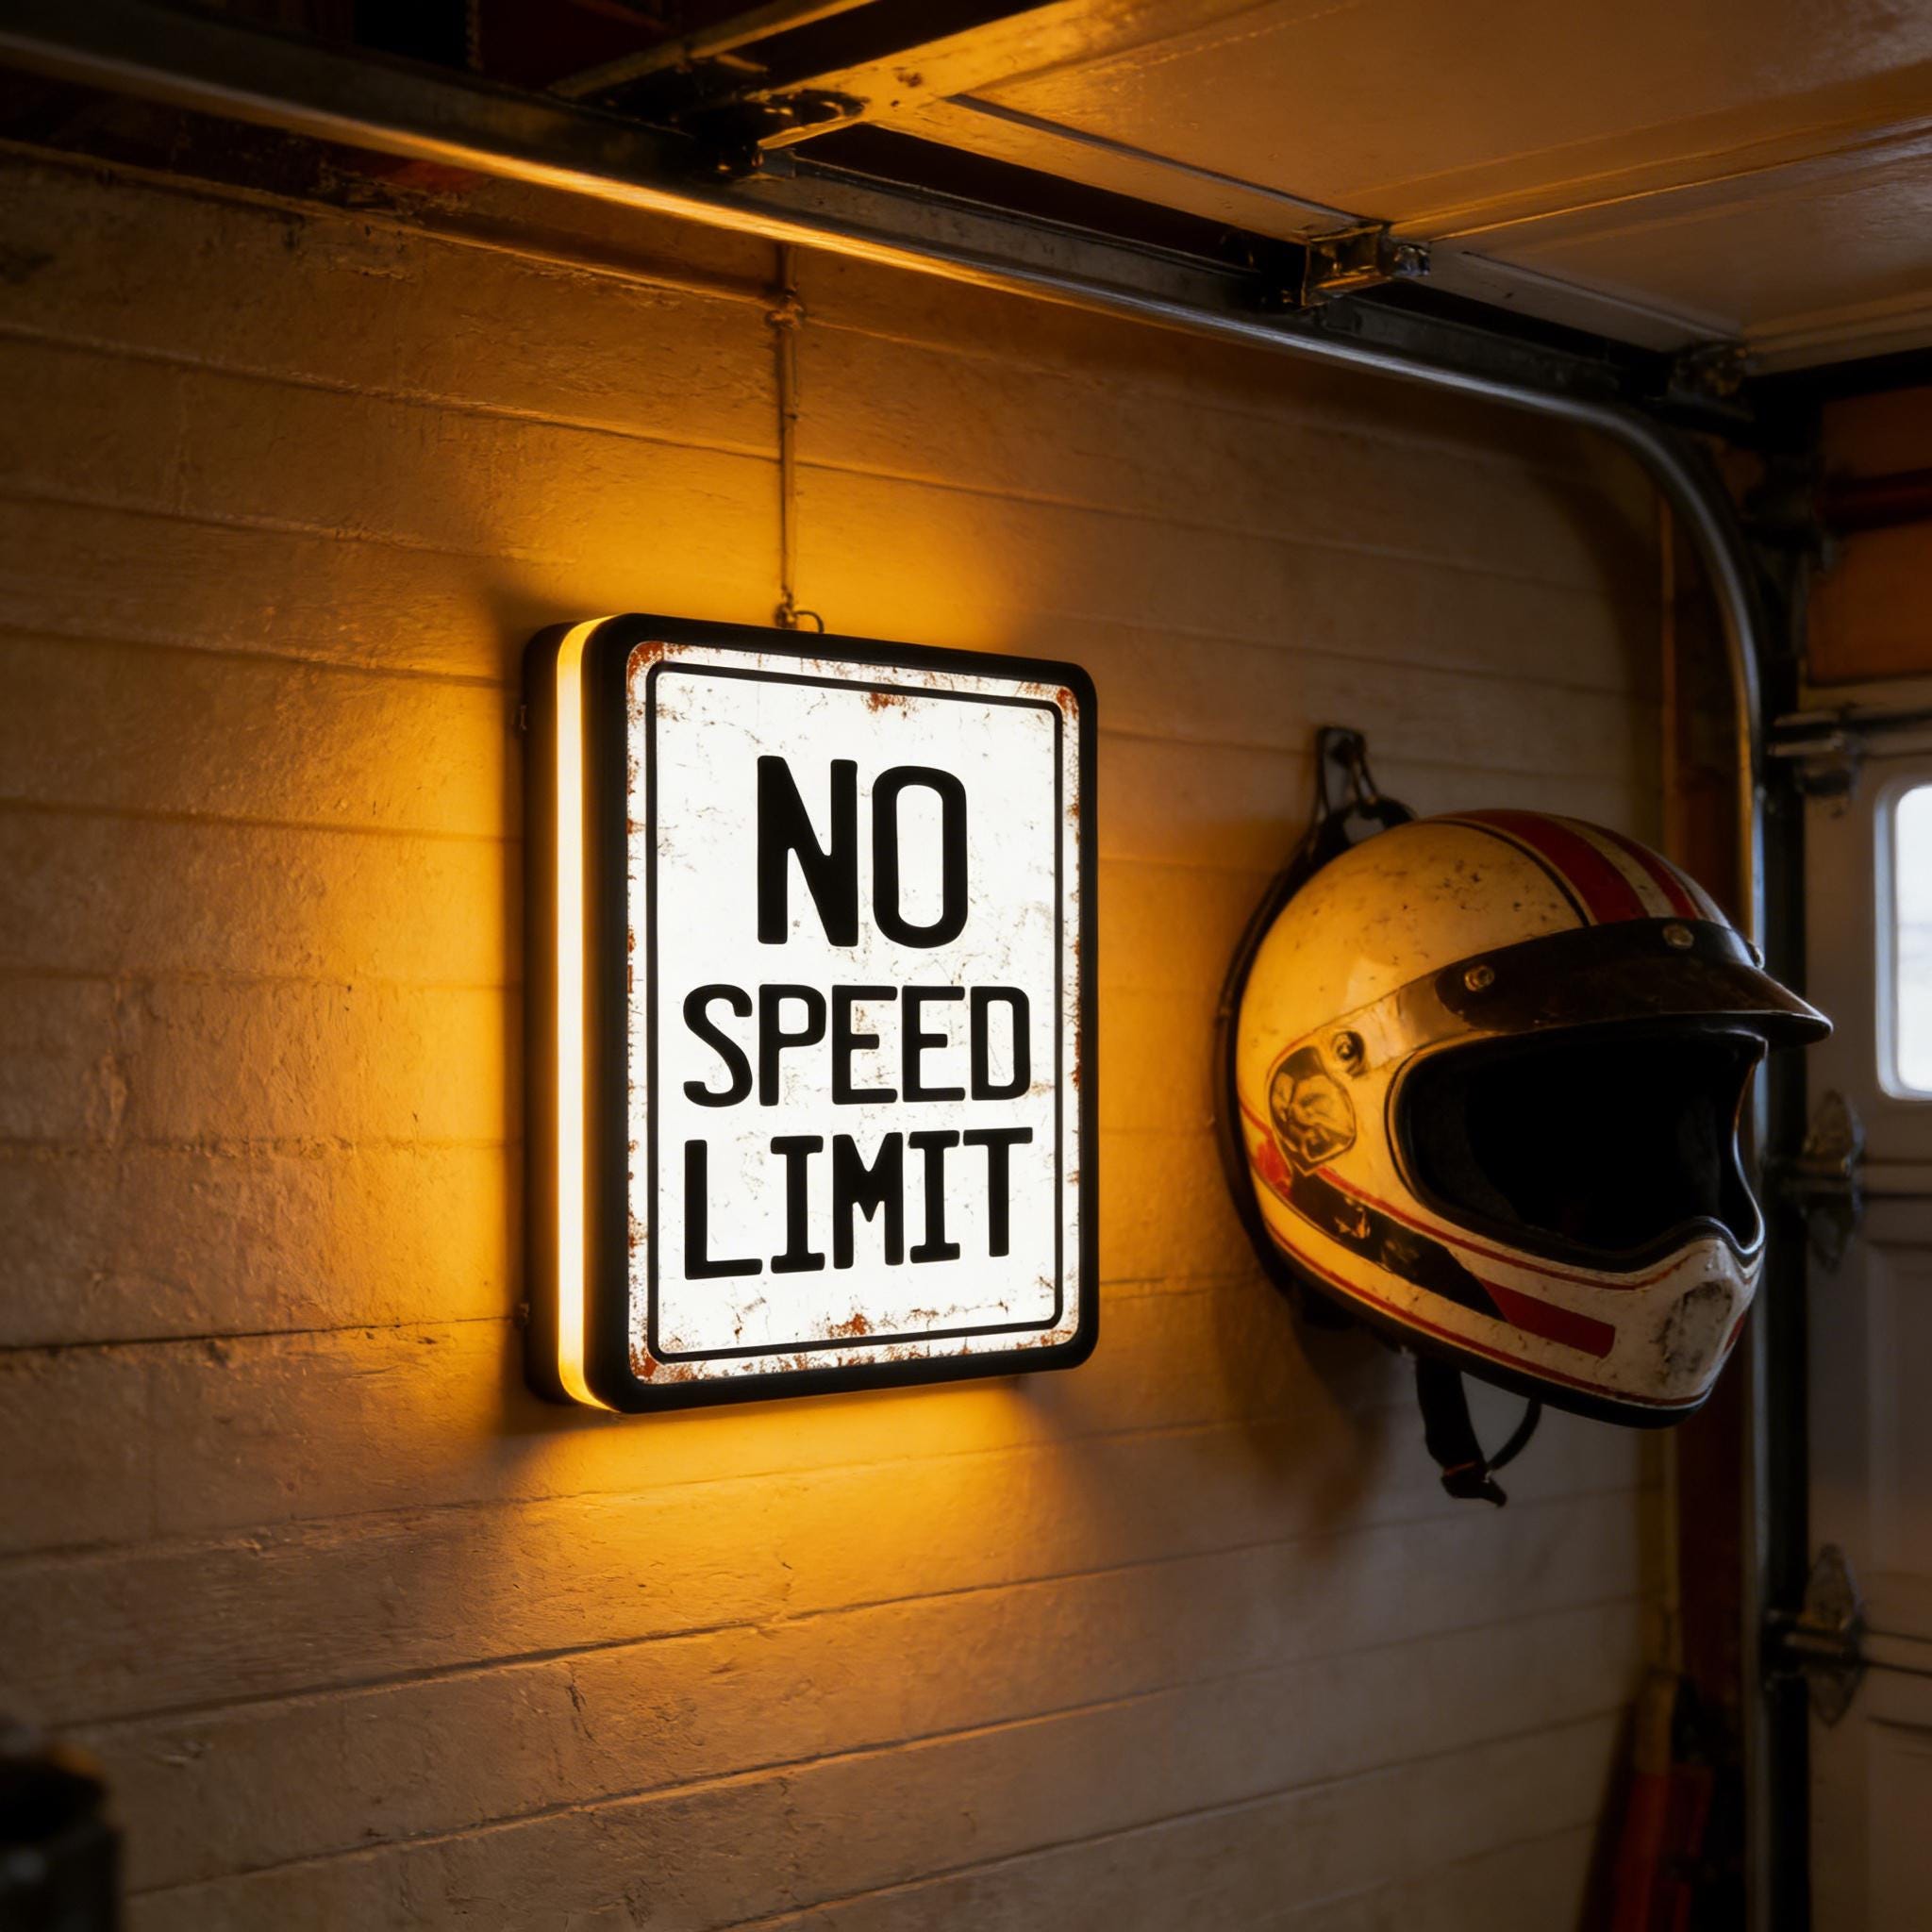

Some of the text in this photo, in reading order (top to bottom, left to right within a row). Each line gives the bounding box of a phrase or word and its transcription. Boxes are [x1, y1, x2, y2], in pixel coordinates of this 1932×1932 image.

[758, 755, 969, 949] NO
[683, 983, 1031, 1108] SPEED
[684, 1126, 1033, 1280] LIMIT
